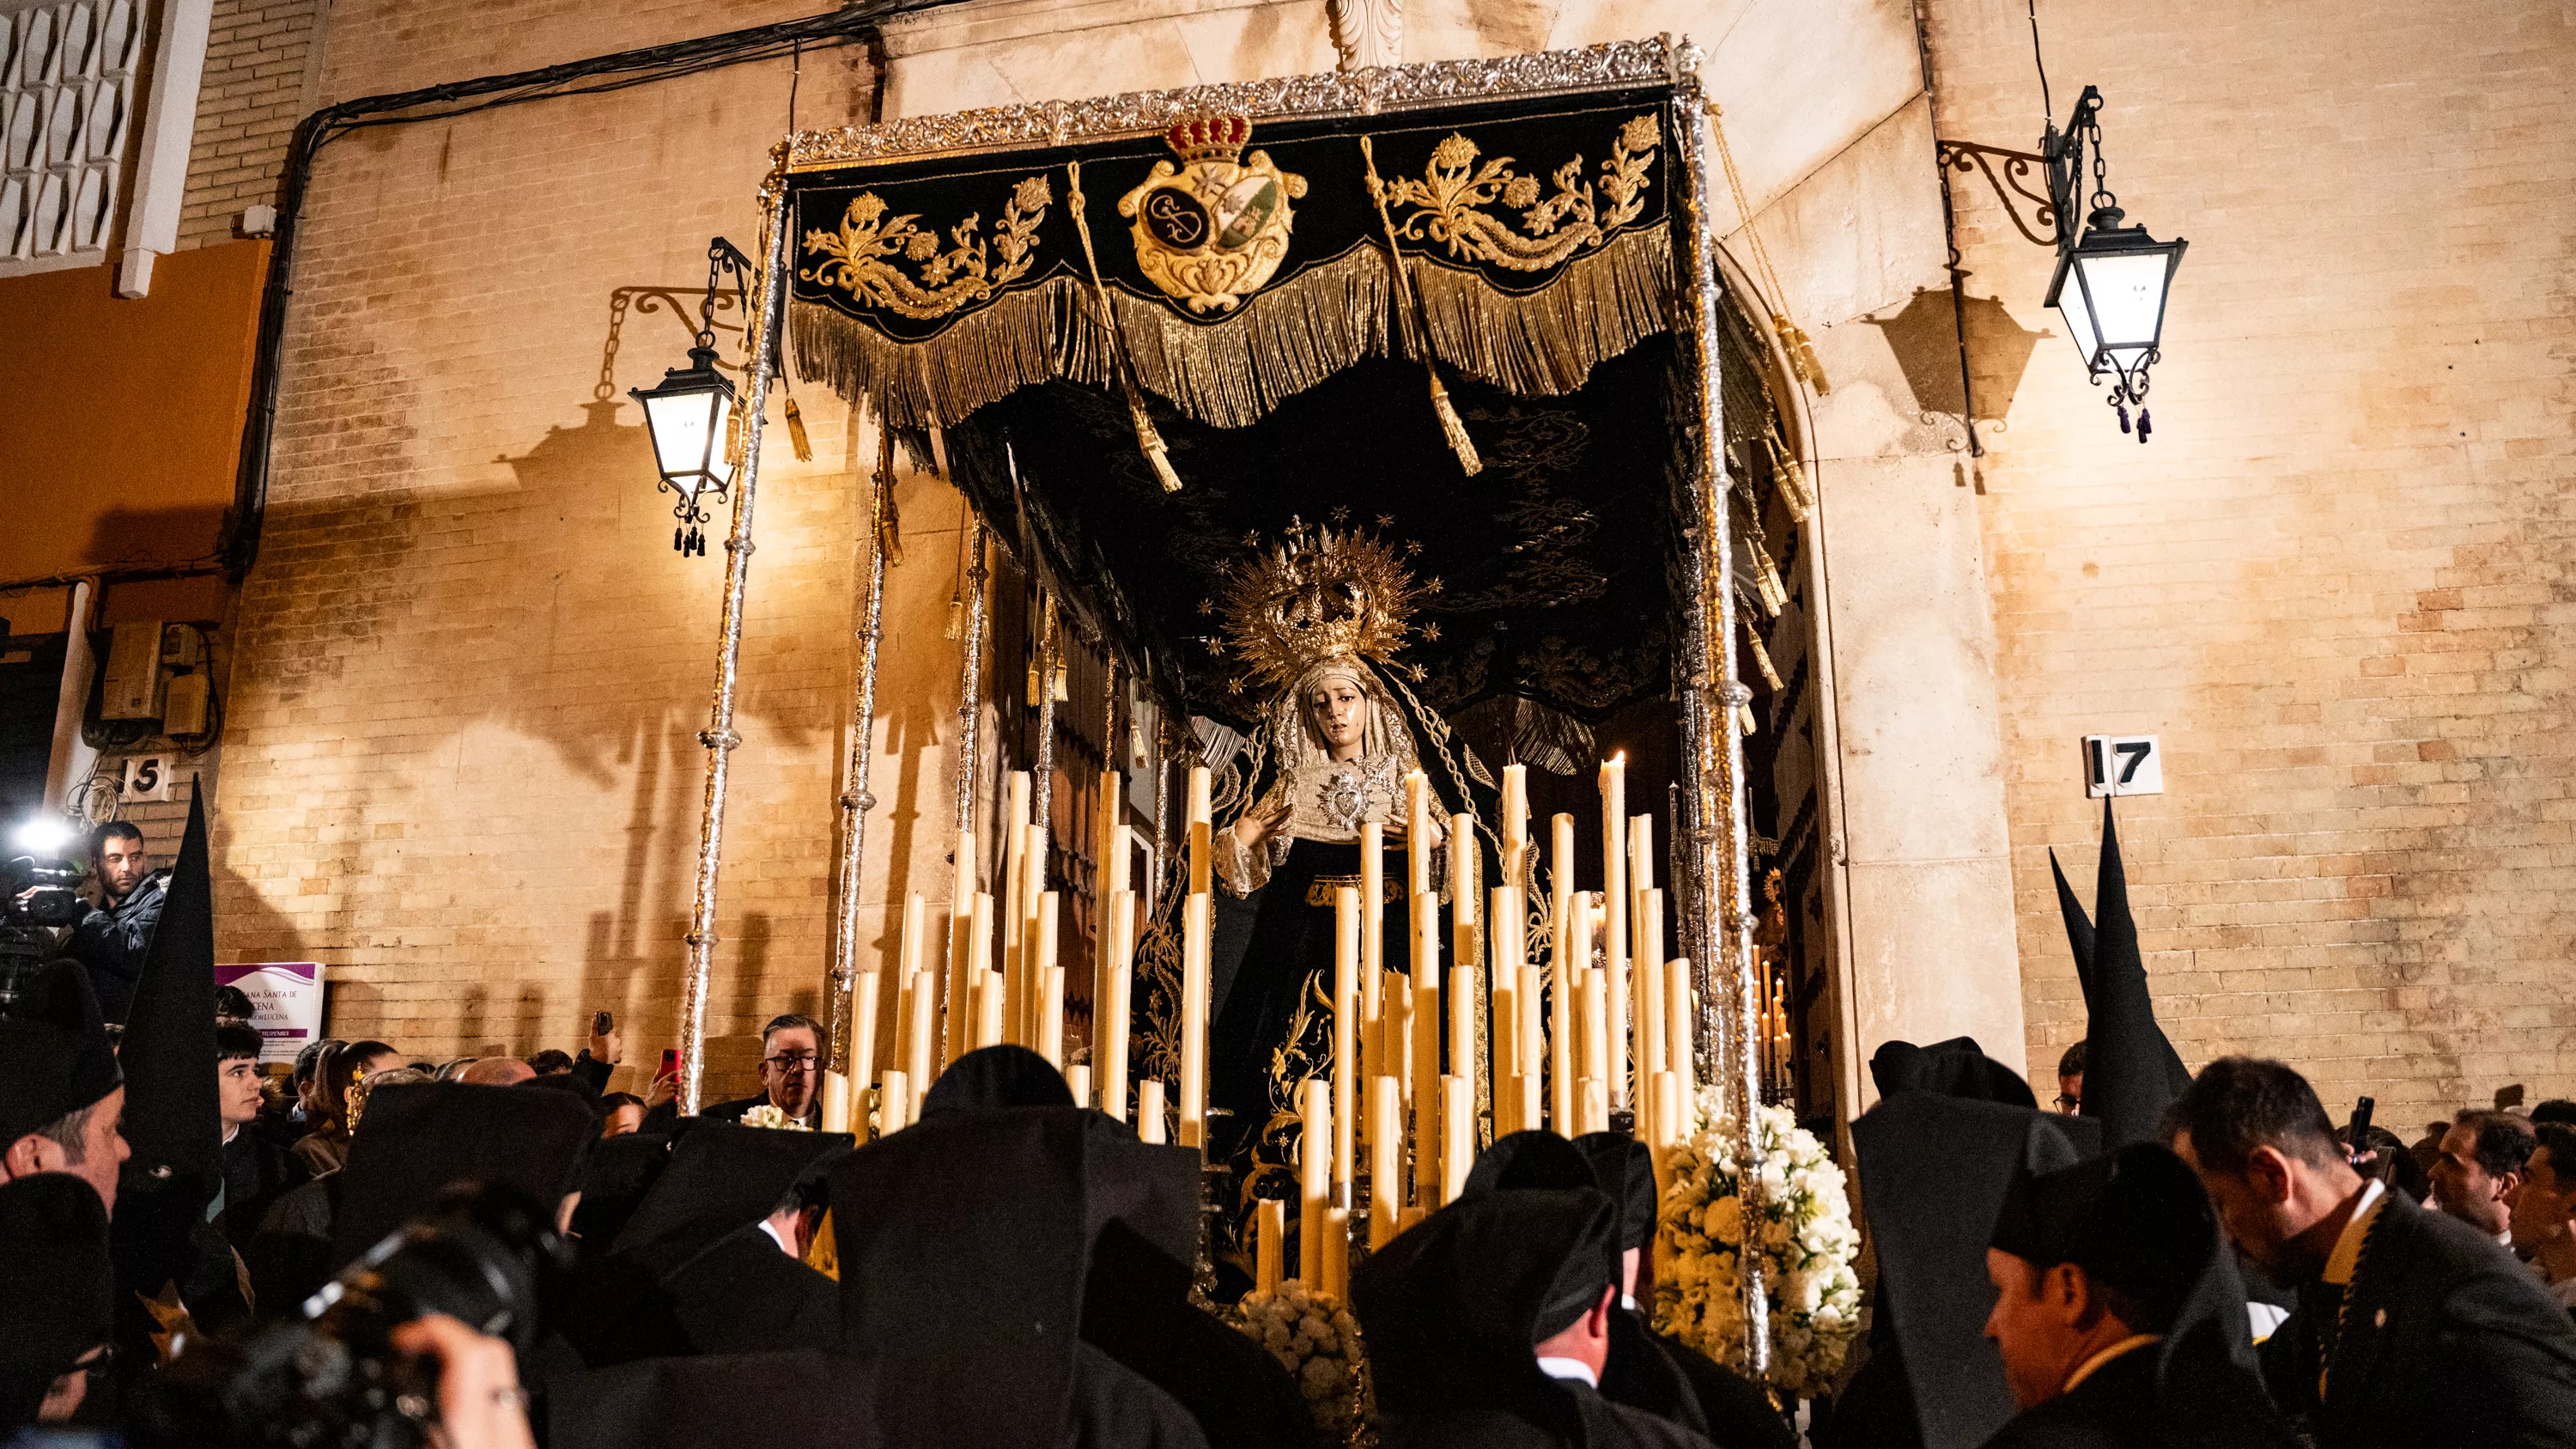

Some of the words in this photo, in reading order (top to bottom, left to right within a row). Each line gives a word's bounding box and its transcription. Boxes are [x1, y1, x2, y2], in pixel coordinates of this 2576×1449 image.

[118, 758, 159, 793] 15
[2090, 740, 2151, 783] 17
[253, 1002, 275, 1011] CENA
